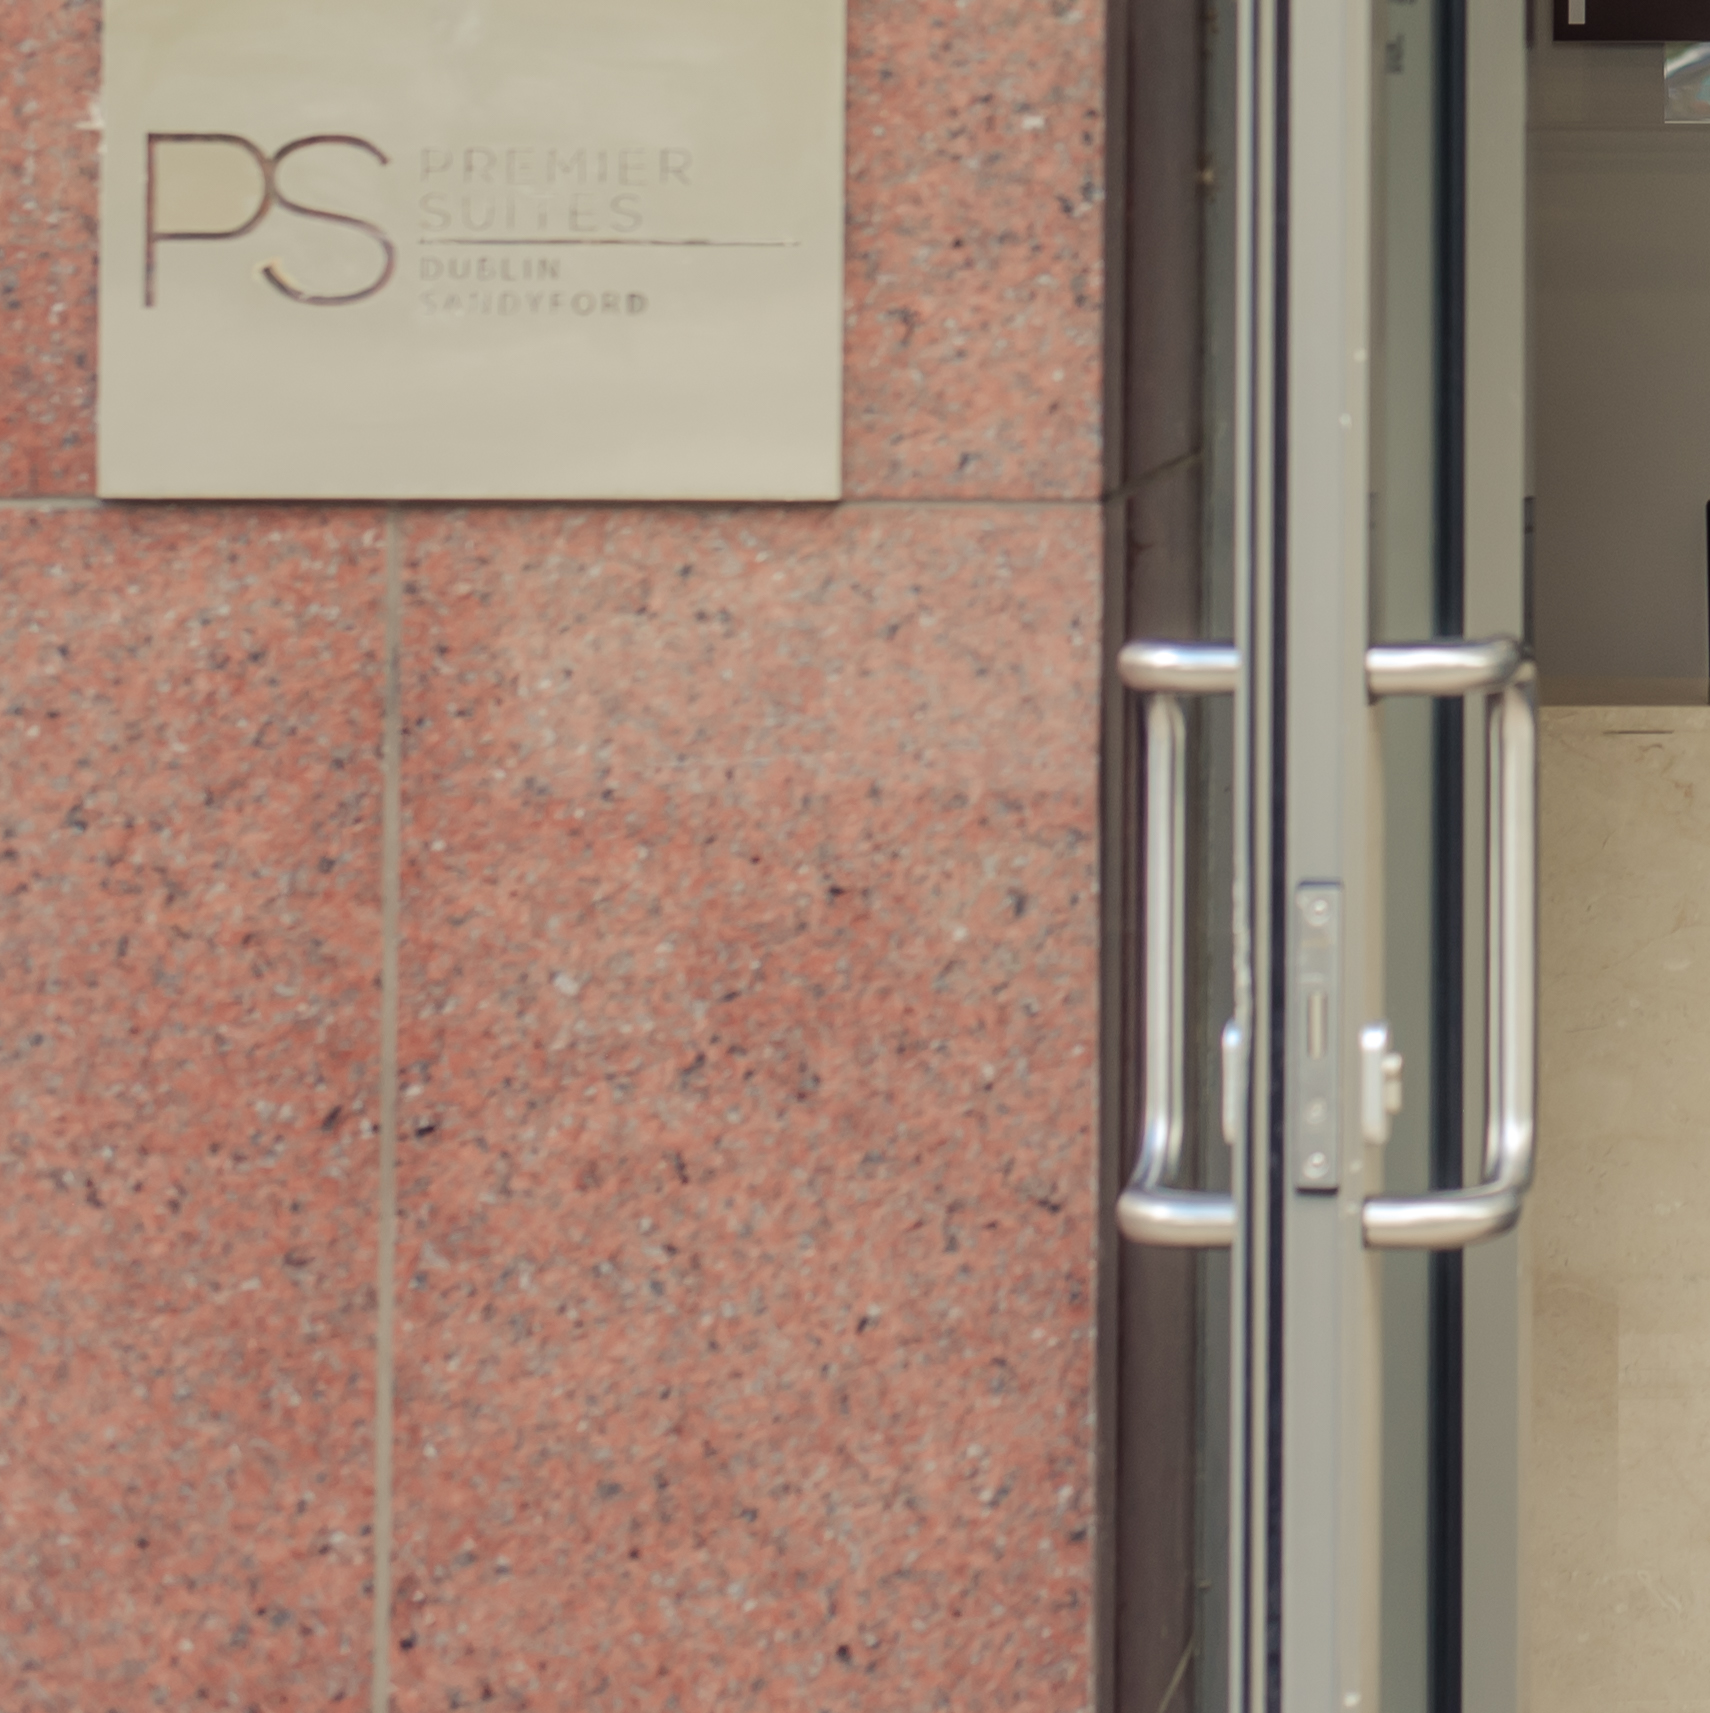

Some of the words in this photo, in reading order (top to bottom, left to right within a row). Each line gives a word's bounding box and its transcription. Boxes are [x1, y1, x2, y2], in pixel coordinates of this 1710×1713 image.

[419, 145, 694, 186] PREMIER
[143, 131, 398, 309] PS
[418, 191, 644, 233] SUITES
[419, 256, 561, 281] DUBLIN
